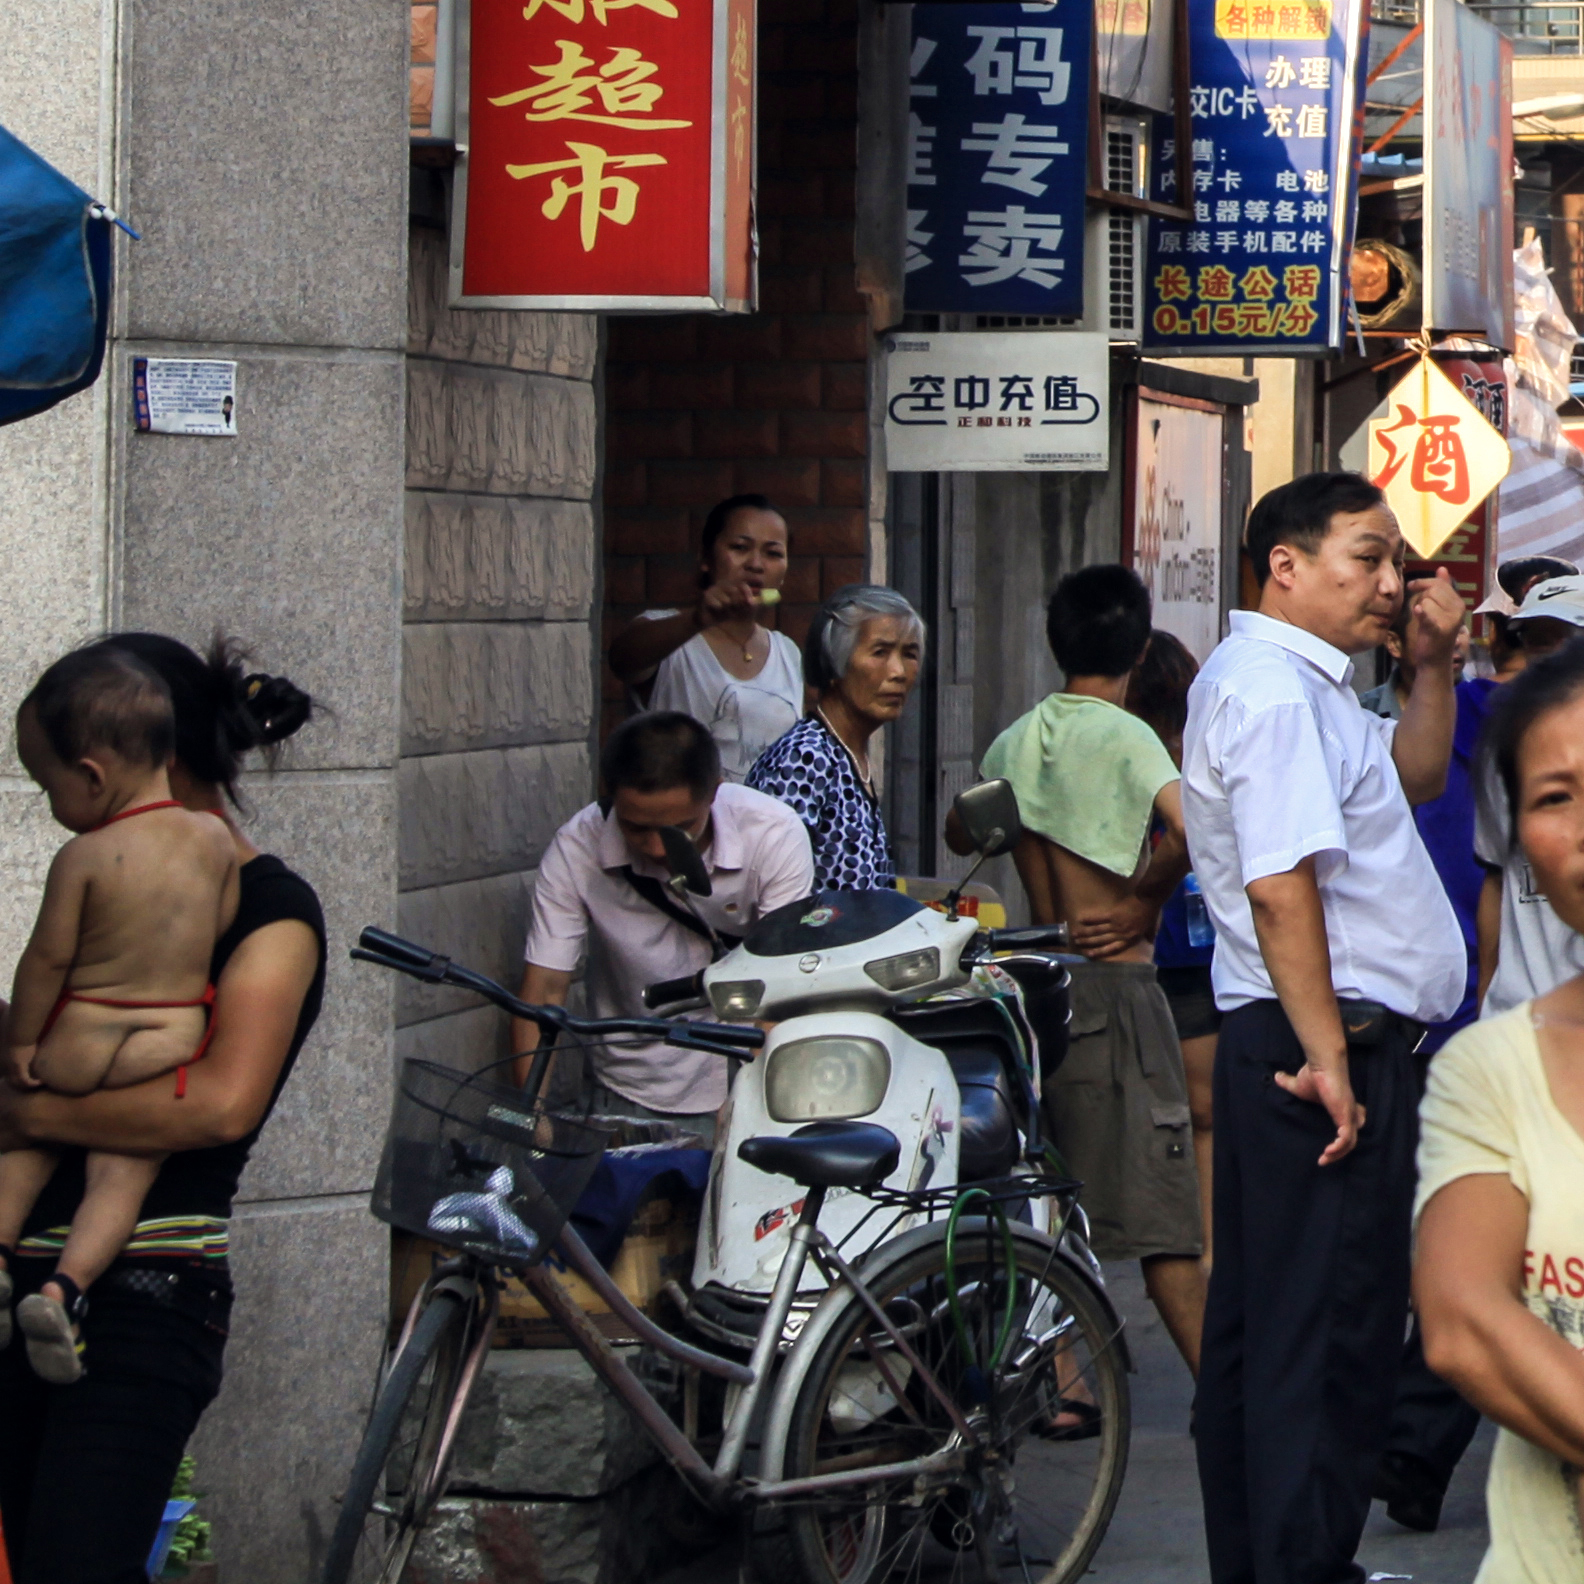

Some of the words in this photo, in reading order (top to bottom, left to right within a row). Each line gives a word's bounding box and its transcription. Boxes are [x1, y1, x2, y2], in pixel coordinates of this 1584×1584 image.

[1226, 4, 1328, 36] 各种解锁
[1265, 56, 1332, 90] 办理
[1170, 84, 1258, 119] 交IC卡
[1262, 104, 1328, 138] 充值
[1276, 169, 1330, 193] 电池
[1160, 200, 1328, 224] 电器等各种
[1157, 231, 1326, 254] 原装手机配件
[1155, 265, 1320, 301] 长途公话
[1153, 302, 1320, 338] 0.15元/分
[909, 374, 1079, 411] 空中充值
[1371, 404, 1470, 505] 酒
